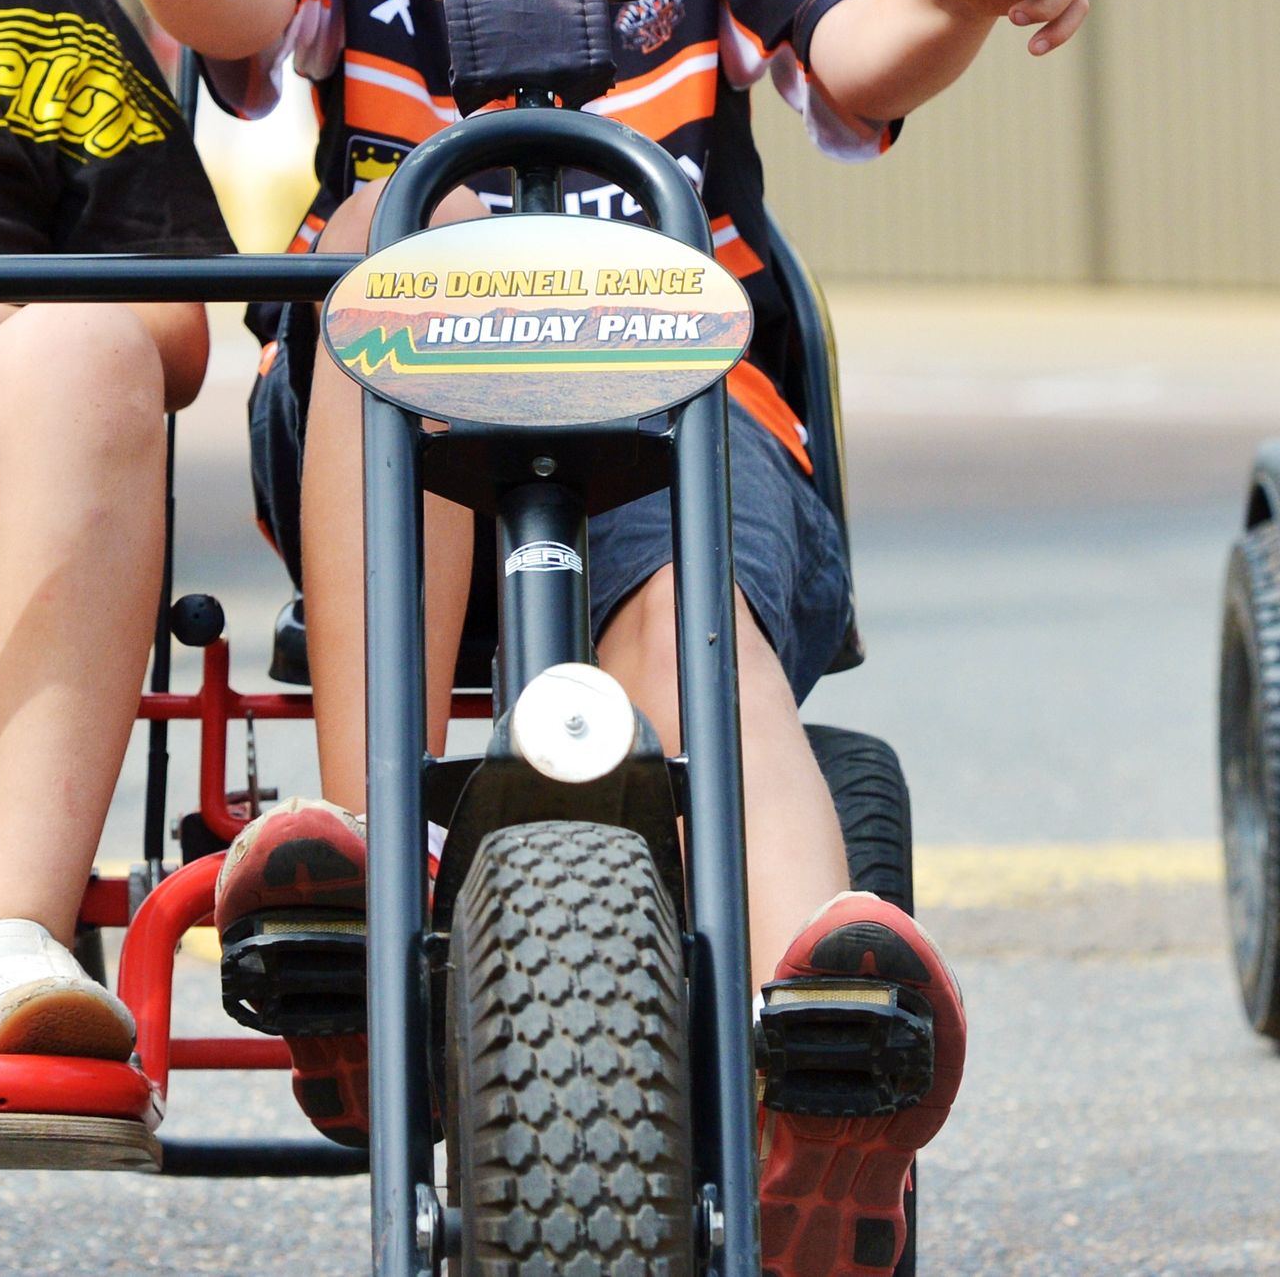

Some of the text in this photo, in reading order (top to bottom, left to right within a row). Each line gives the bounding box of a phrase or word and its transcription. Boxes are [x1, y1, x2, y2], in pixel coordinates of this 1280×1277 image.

[366, 267, 706, 299] MAC DONNELL RANGE
[425, 313, 705, 344] HOLIDAY PARK
[505, 548, 583, 577] BERG
